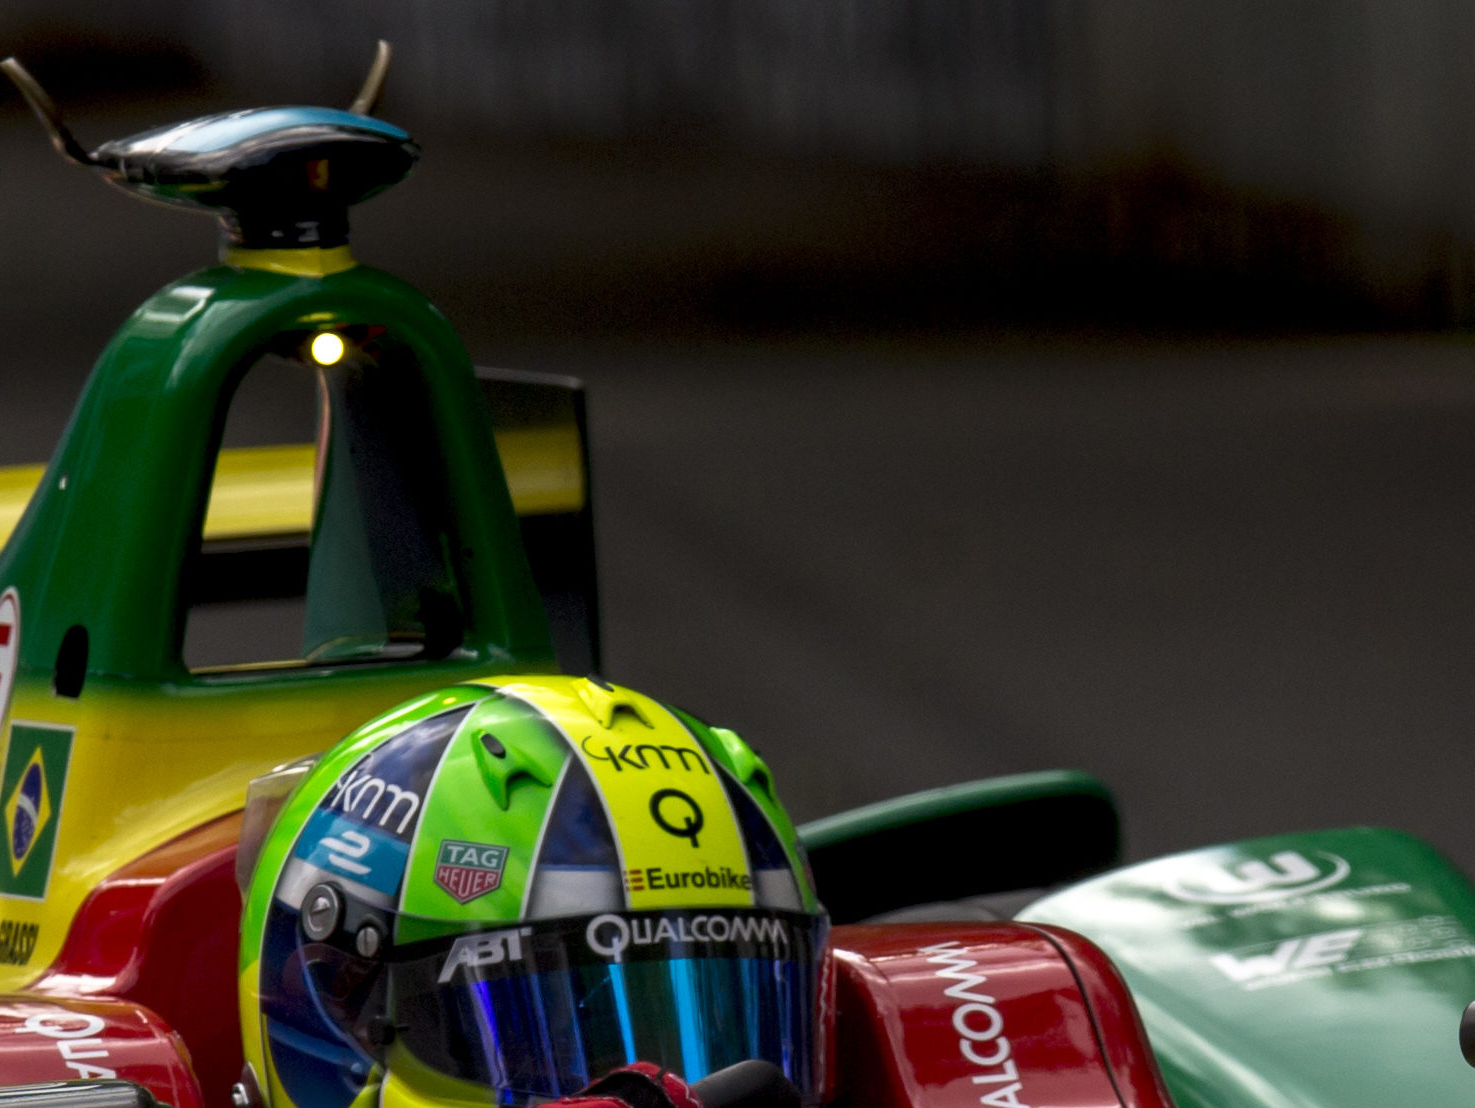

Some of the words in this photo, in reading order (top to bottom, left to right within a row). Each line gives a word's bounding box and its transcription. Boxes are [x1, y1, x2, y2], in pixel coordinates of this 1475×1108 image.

[649, 788, 704, 848] Q
[447, 846, 500, 868] TAG
[437, 868, 496, 898] HEUER
[646, 866, 751, 891] Eurobike
[436, 927, 533, 984] ABT
[586, 913, 788, 963] QUALCOMM
